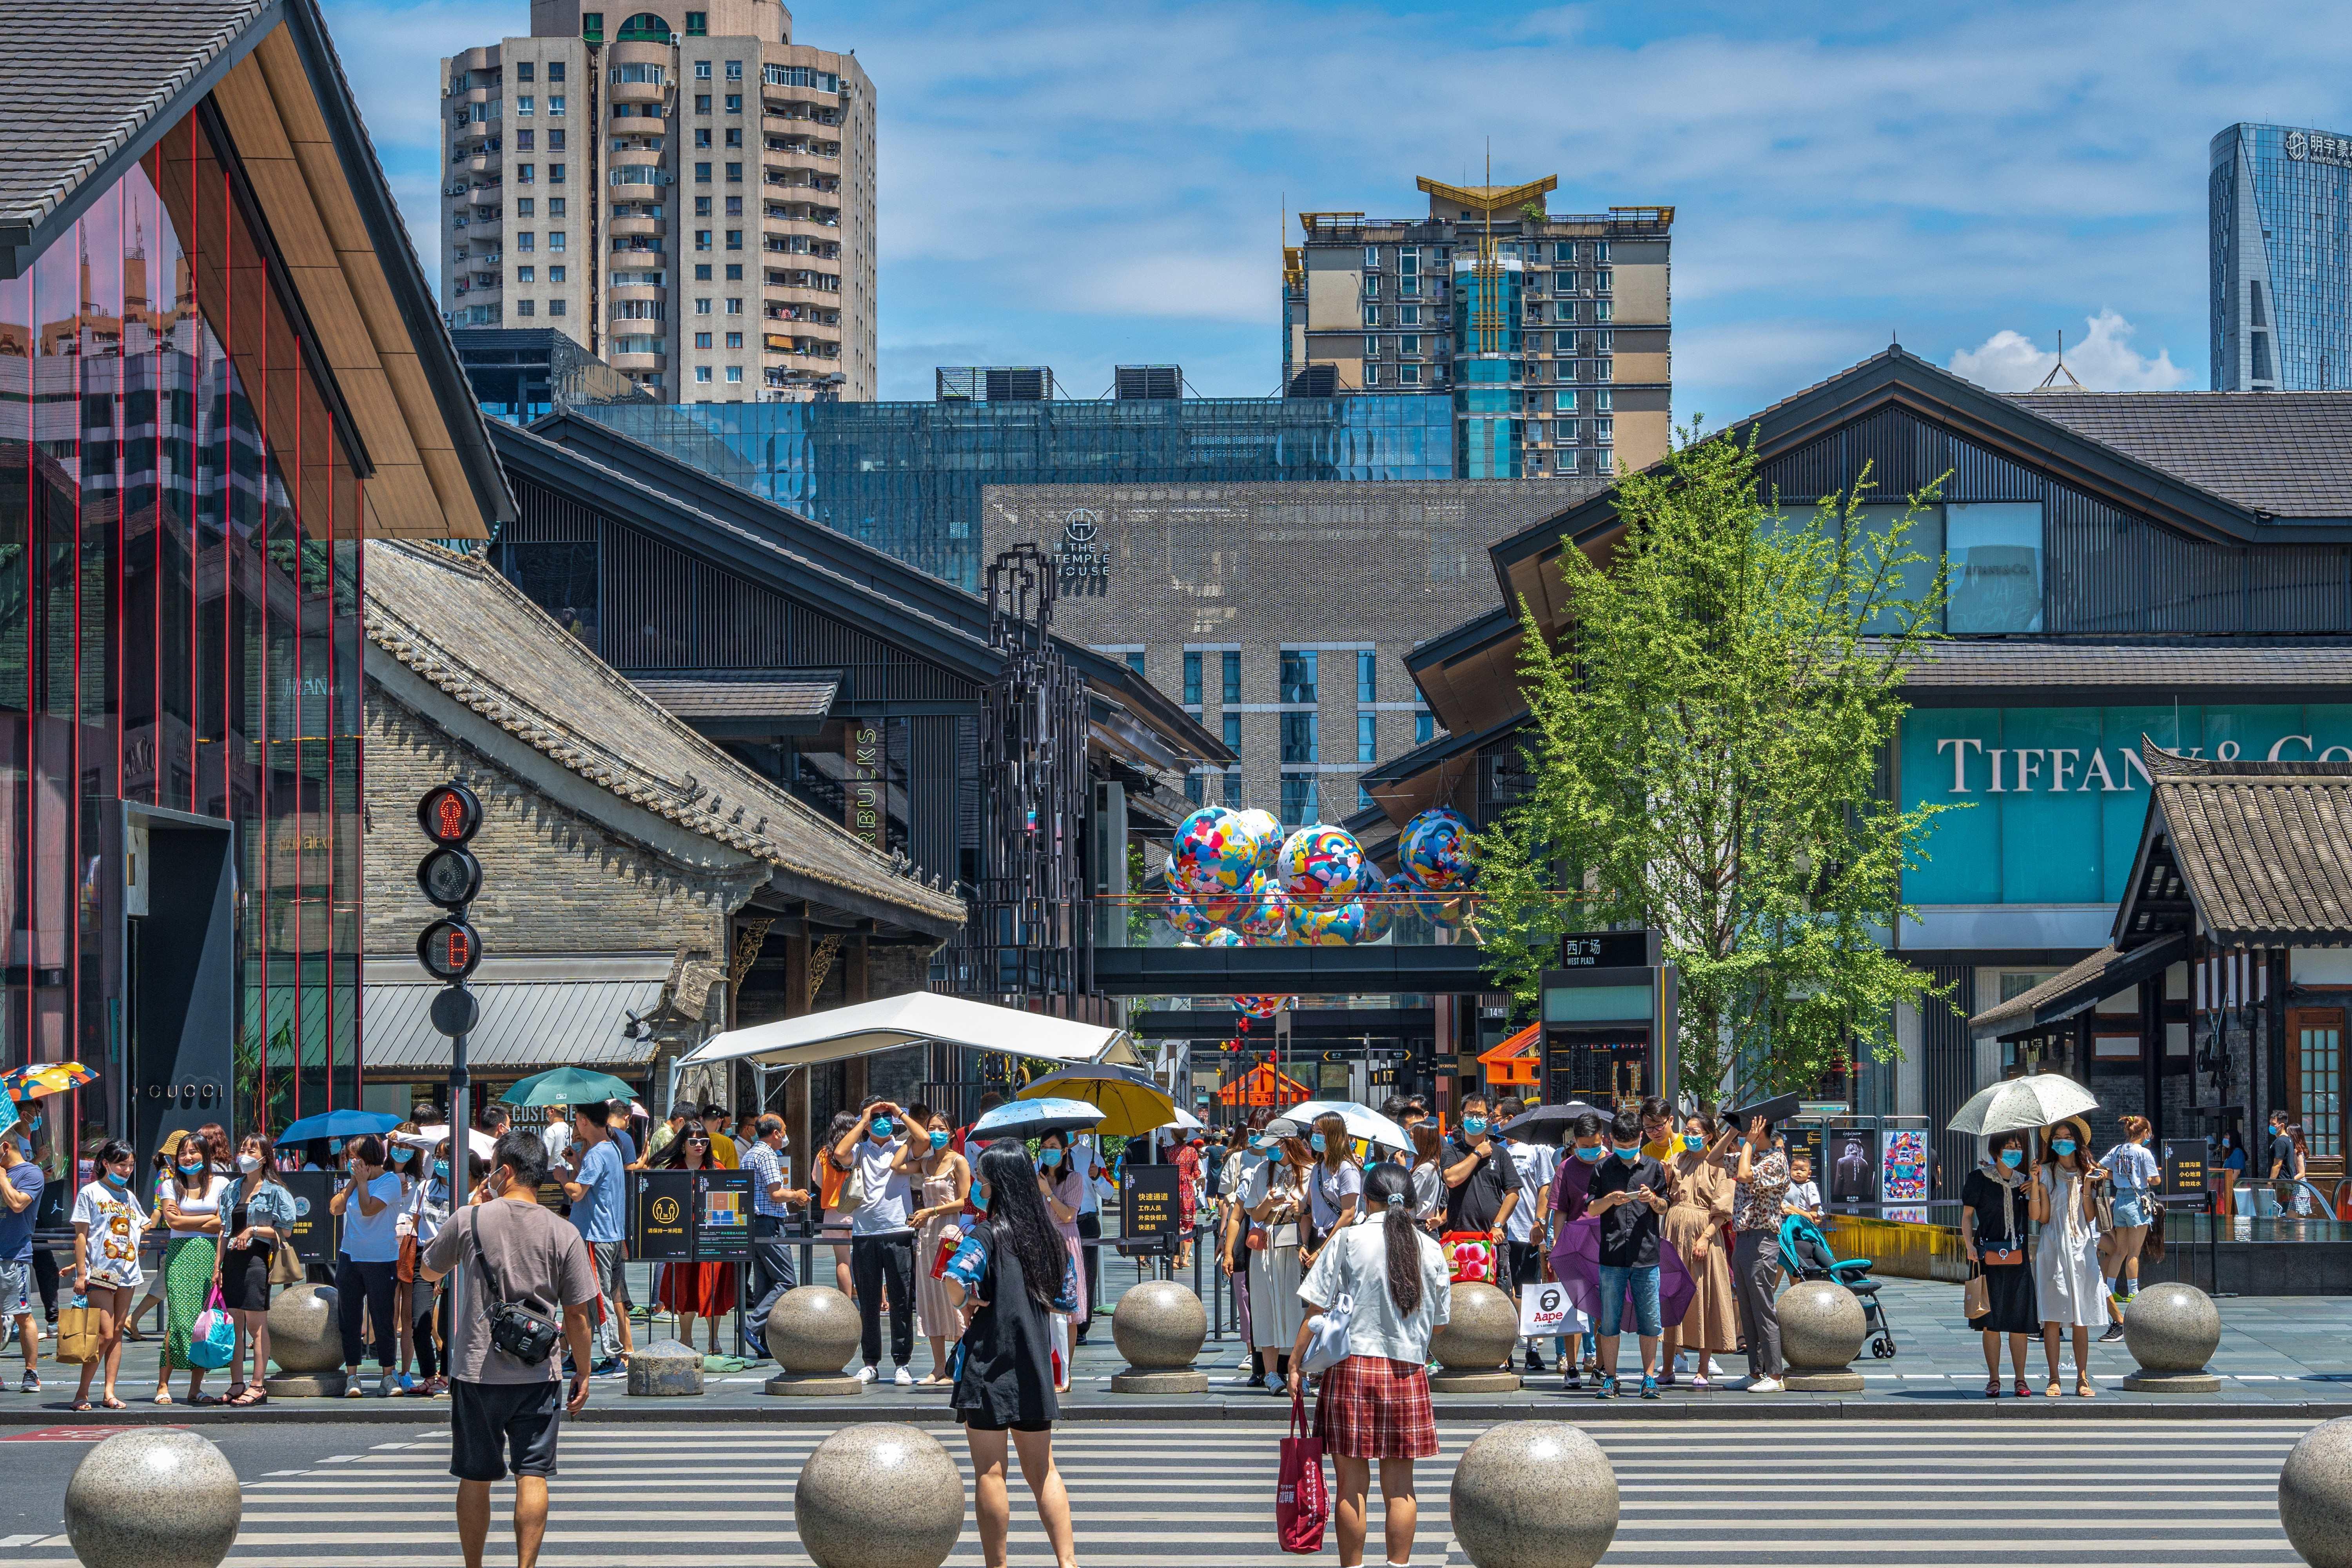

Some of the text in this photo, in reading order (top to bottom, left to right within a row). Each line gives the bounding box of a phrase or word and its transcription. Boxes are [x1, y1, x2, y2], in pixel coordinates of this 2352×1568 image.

[2310, 135, 2352, 157] 明宇豪
[2310, 156, 2339, 165] MINYOUN
[1069, 543, 1096, 552] THE
[1054, 554, 1110, 563] TEMPLE
[1567, 939, 1600, 956] 西广场
[150, 1084, 223, 1098] GUCCI
[1534, 1312, 1563, 1324] Aape
